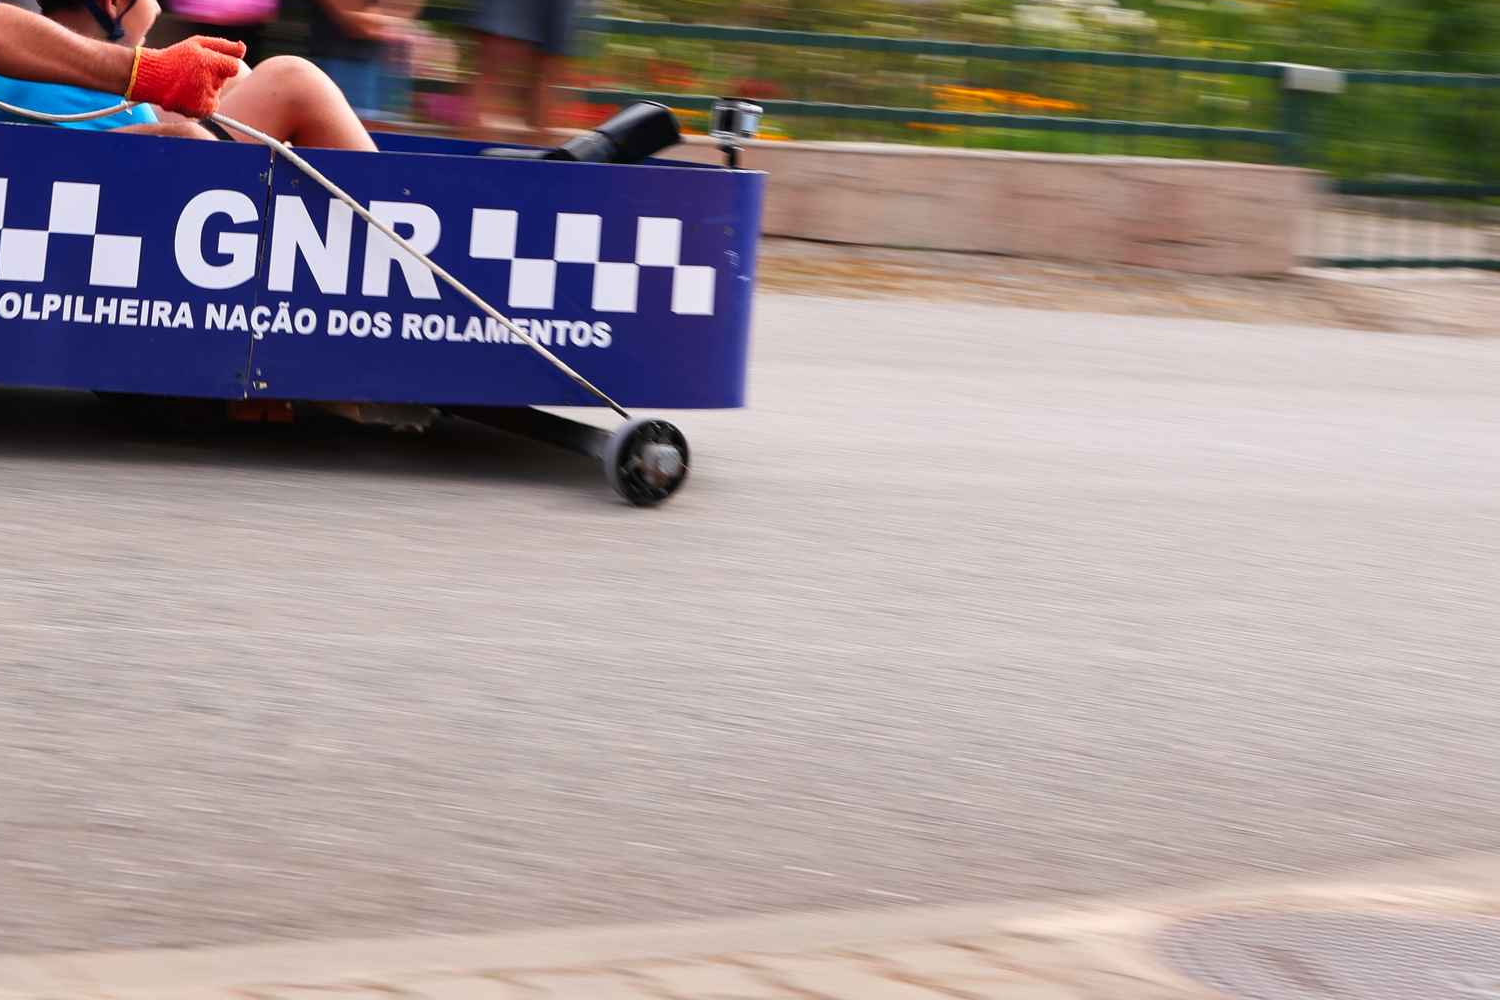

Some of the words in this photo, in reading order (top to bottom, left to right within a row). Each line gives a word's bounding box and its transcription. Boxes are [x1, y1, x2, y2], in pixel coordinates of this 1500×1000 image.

[175, 189, 442, 300] GNR
[204, 301, 317, 340] NAÇÃO
[327, 309, 392, 339] DOS
[401, 313, 613, 349] ROLAMENTOS
